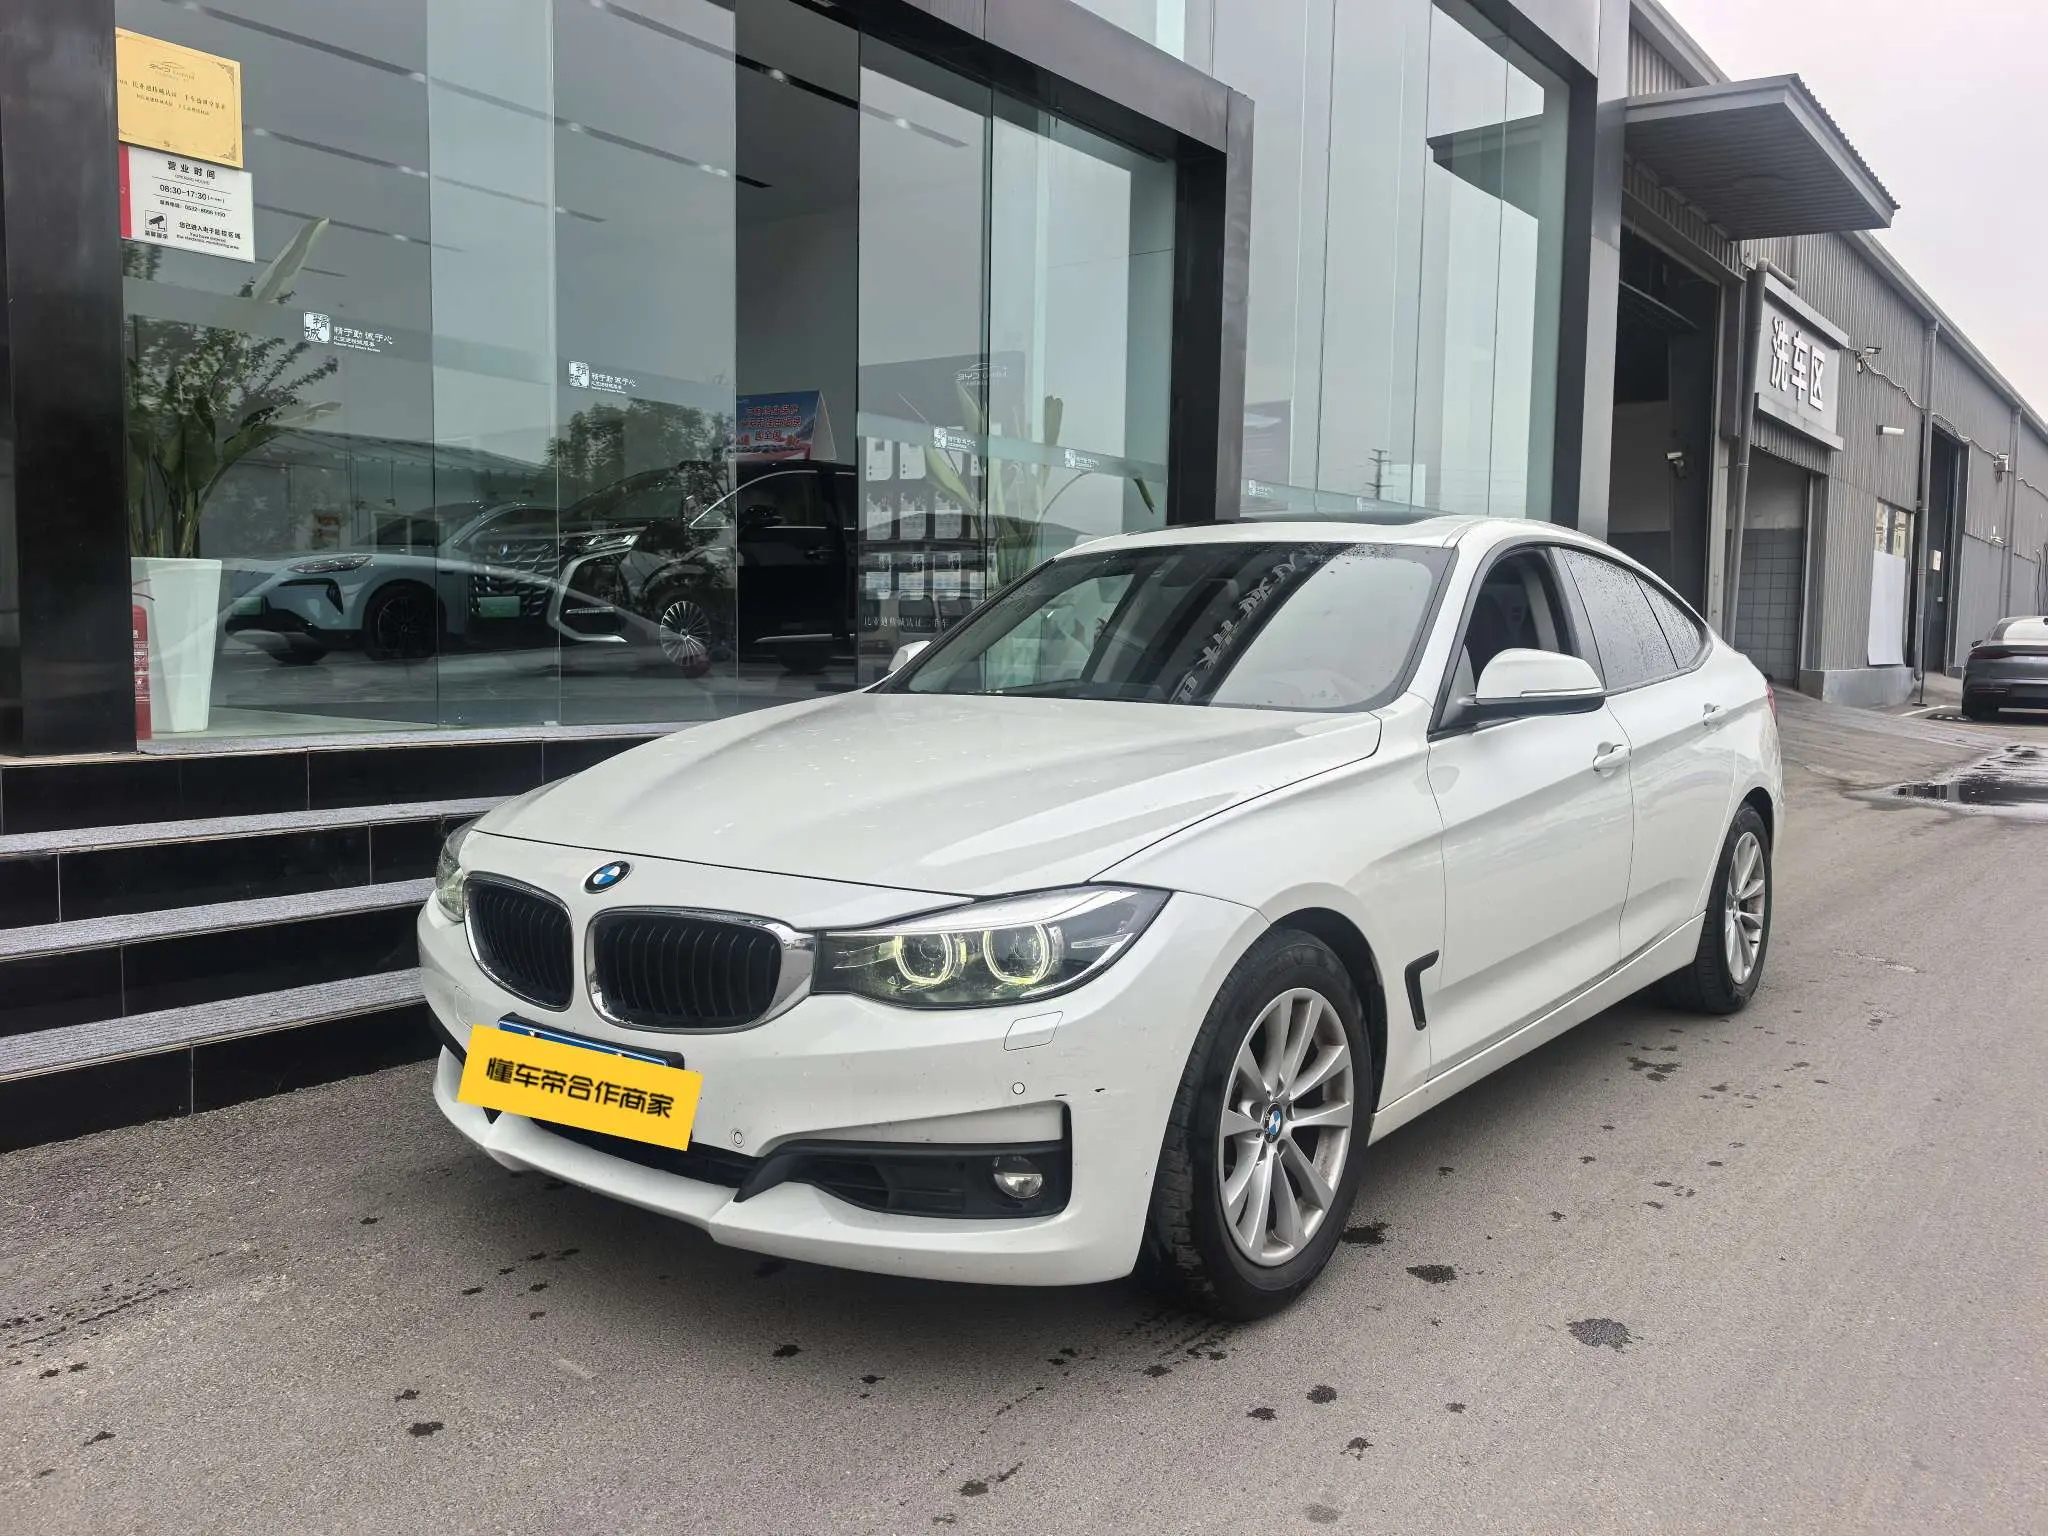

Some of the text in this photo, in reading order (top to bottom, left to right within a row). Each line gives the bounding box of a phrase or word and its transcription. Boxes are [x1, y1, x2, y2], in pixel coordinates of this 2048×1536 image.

[167, 160, 216, 180] 营业时间
[1770, 316, 1826, 412] 洗车区
